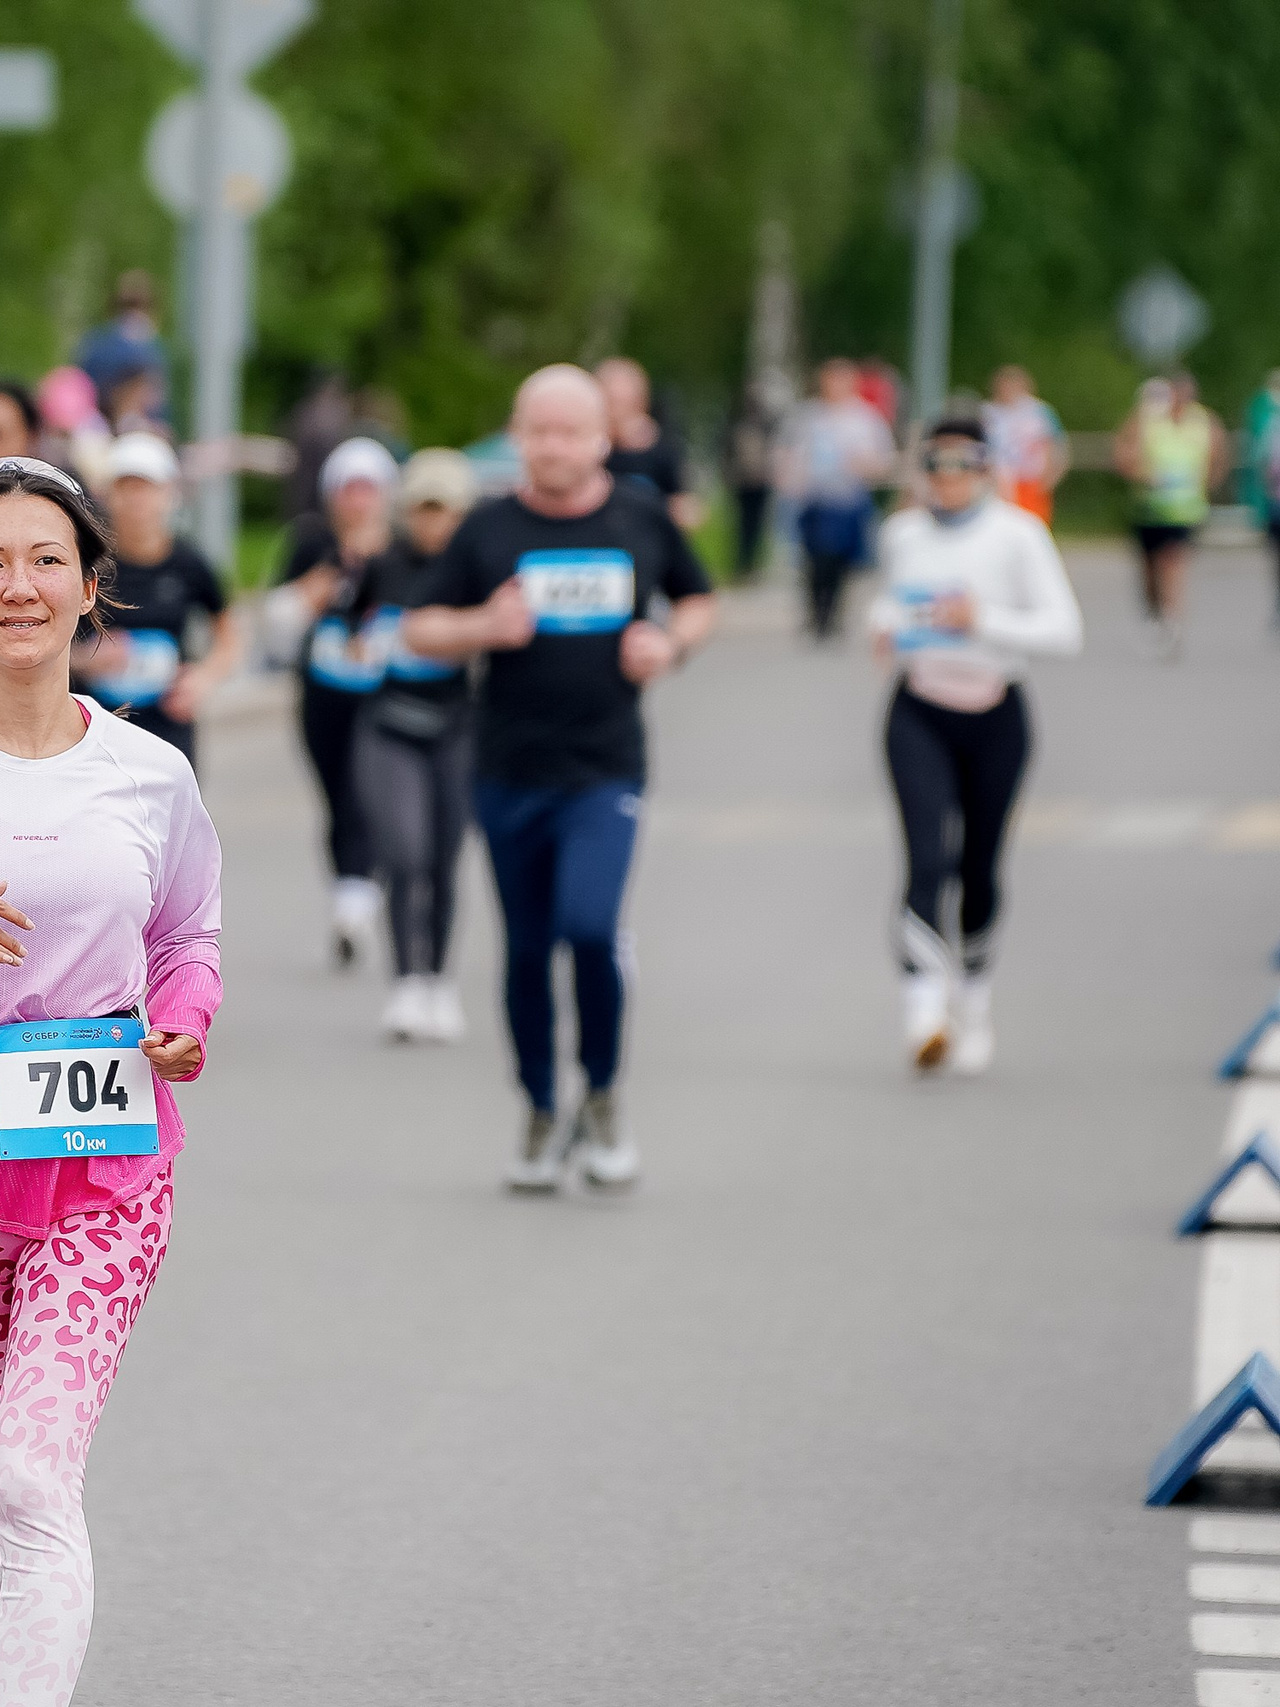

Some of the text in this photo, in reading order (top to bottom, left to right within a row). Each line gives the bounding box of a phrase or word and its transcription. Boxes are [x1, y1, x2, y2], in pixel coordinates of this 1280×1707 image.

[34, 1031, 59, 1040] СБЕР
[28, 1060, 128, 1114] 704
[62, 1130, 86, 1151] 10
